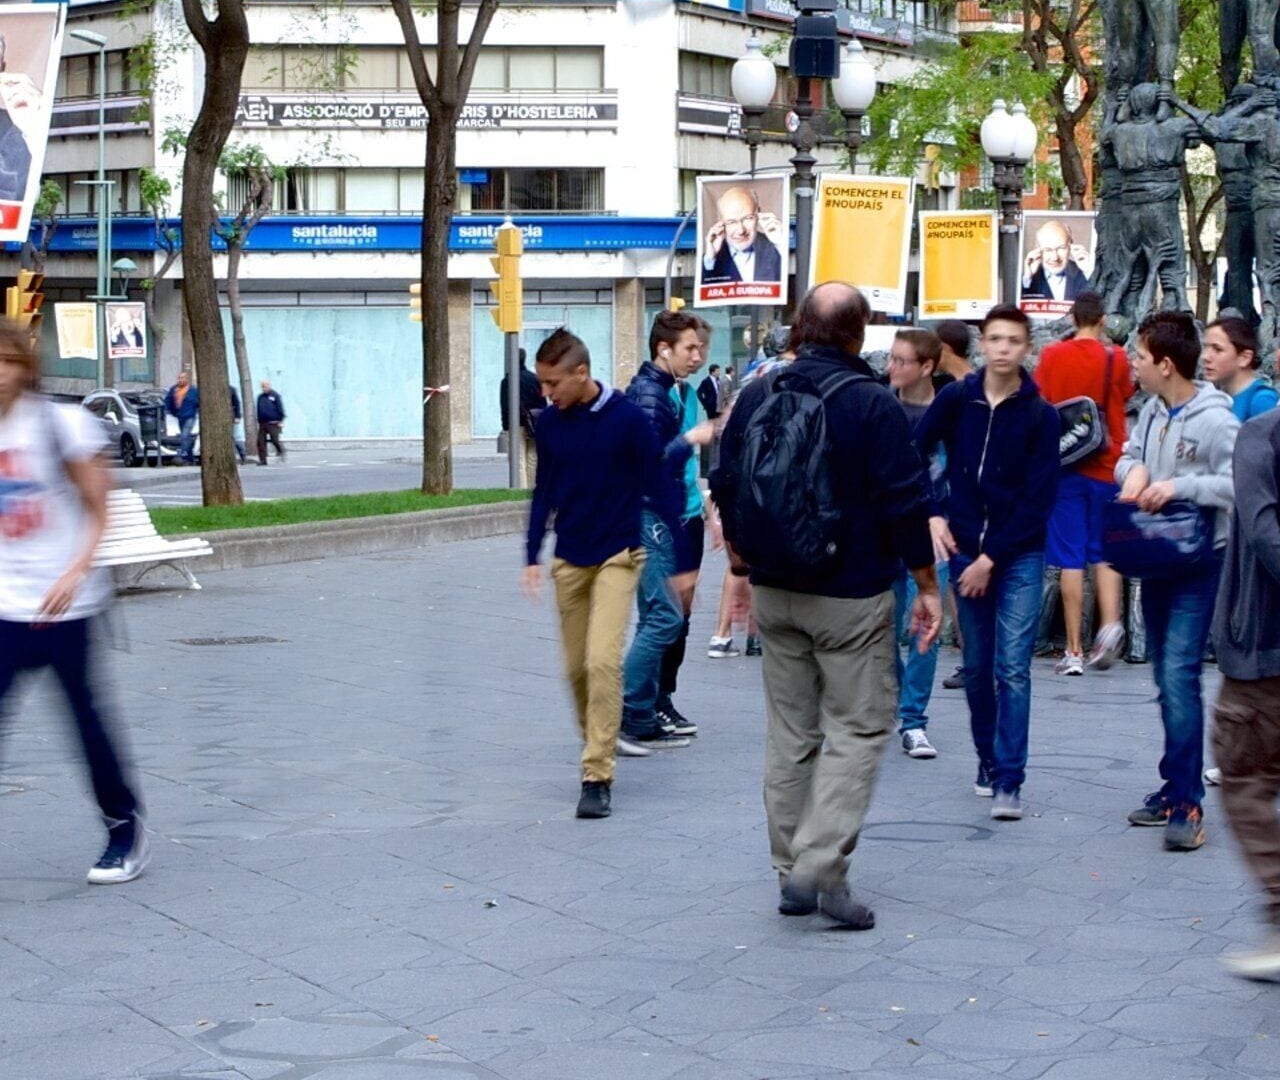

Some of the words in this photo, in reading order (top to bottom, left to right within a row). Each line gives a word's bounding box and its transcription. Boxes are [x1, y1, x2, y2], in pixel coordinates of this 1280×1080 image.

[283, 103, 374, 119] ASSOCIACIÓ
[379, 103, 487, 119] D'EMPRIS
[492, 105, 598, 119] D'HOSTELERIA
[825, 186, 888, 199] COMENCEM
[891, 190, 904, 200] EL
[927, 221, 977, 230] COMENCEM
[979, 220, 990, 229] EL
